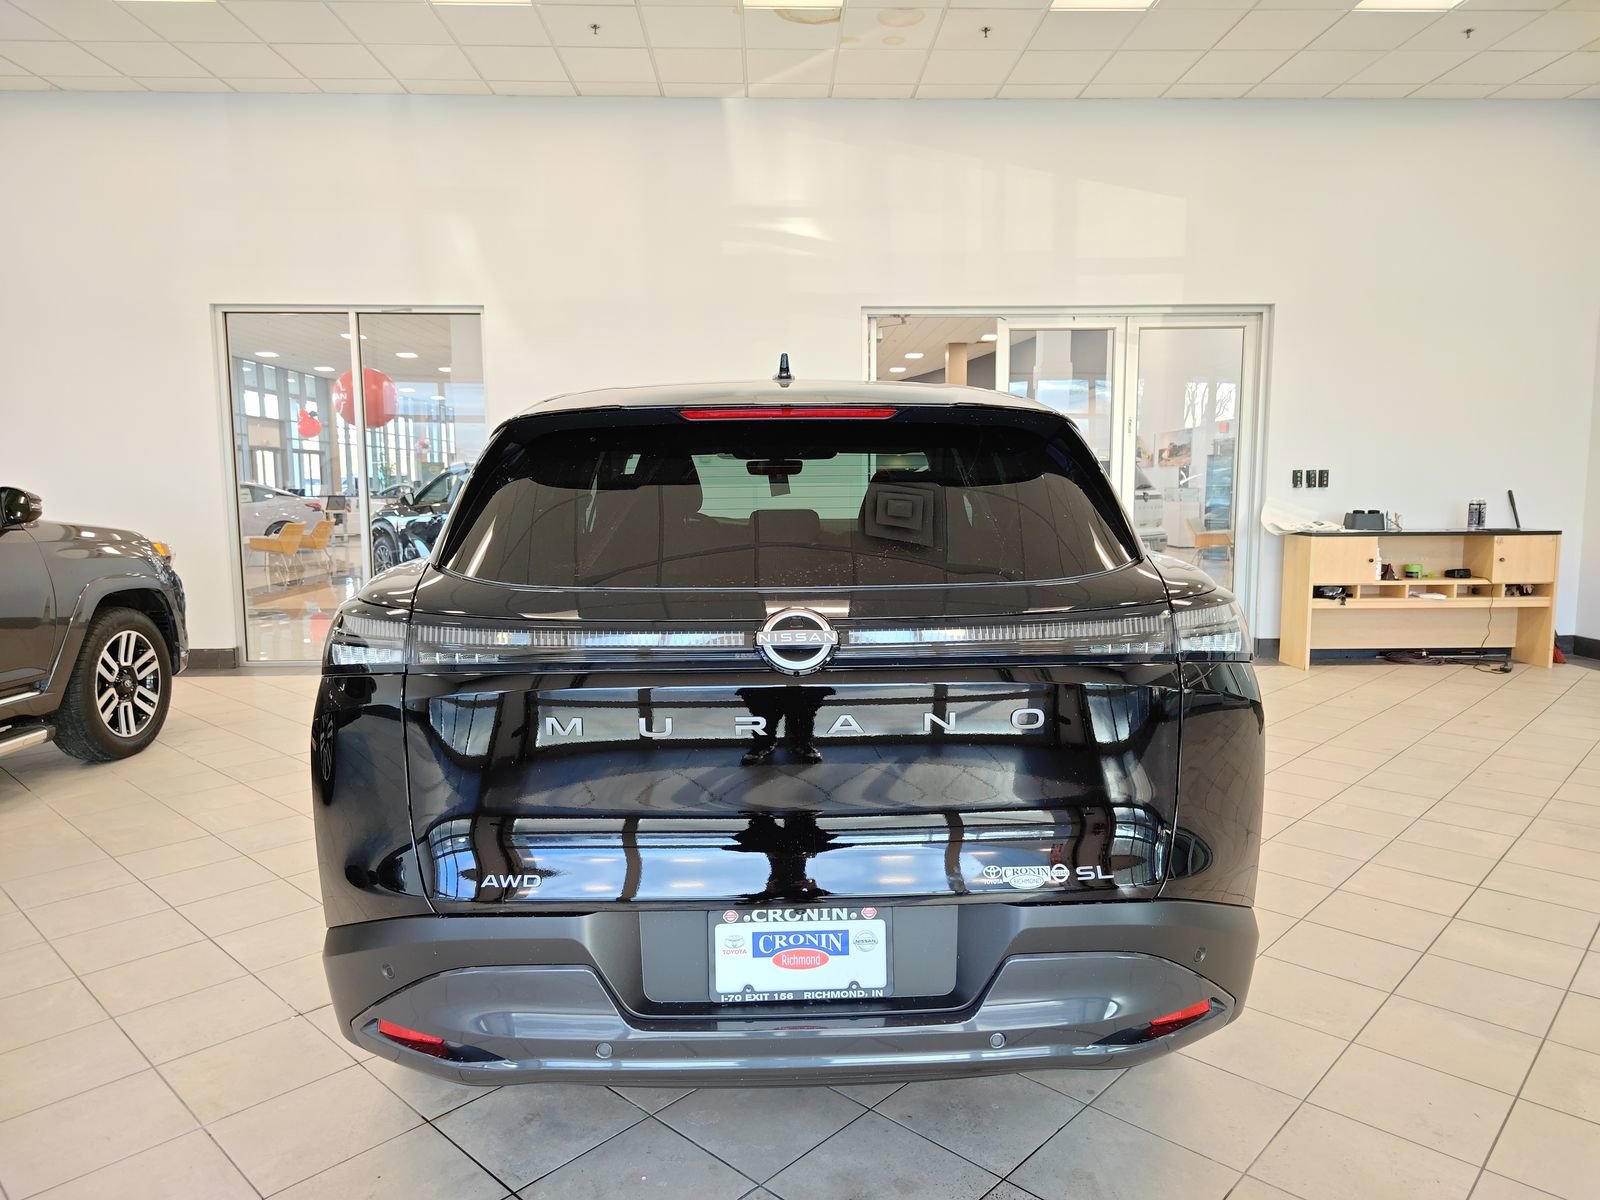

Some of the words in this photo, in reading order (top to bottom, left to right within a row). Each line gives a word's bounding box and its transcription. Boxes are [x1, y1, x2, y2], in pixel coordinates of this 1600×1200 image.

[758, 632, 836, 642] NISSAN
[545, 707, 1046, 738] MURANO
[1003, 867, 1050, 878] CRONIN
[1076, 865, 1114, 880] SL
[480, 874, 542, 888] AWD
[751, 908, 848, 922] CRONIN
[758, 933, 843, 954] CRONIN
[781, 954, 821, 966] Richmond
[720, 994, 742, 1003] I-70
[745, 993, 770, 1001] EXIT
[774, 992, 794, 1001] 156
[803, 990, 868, 999] RICHMOND,
[871, 989, 883, 997] IN
